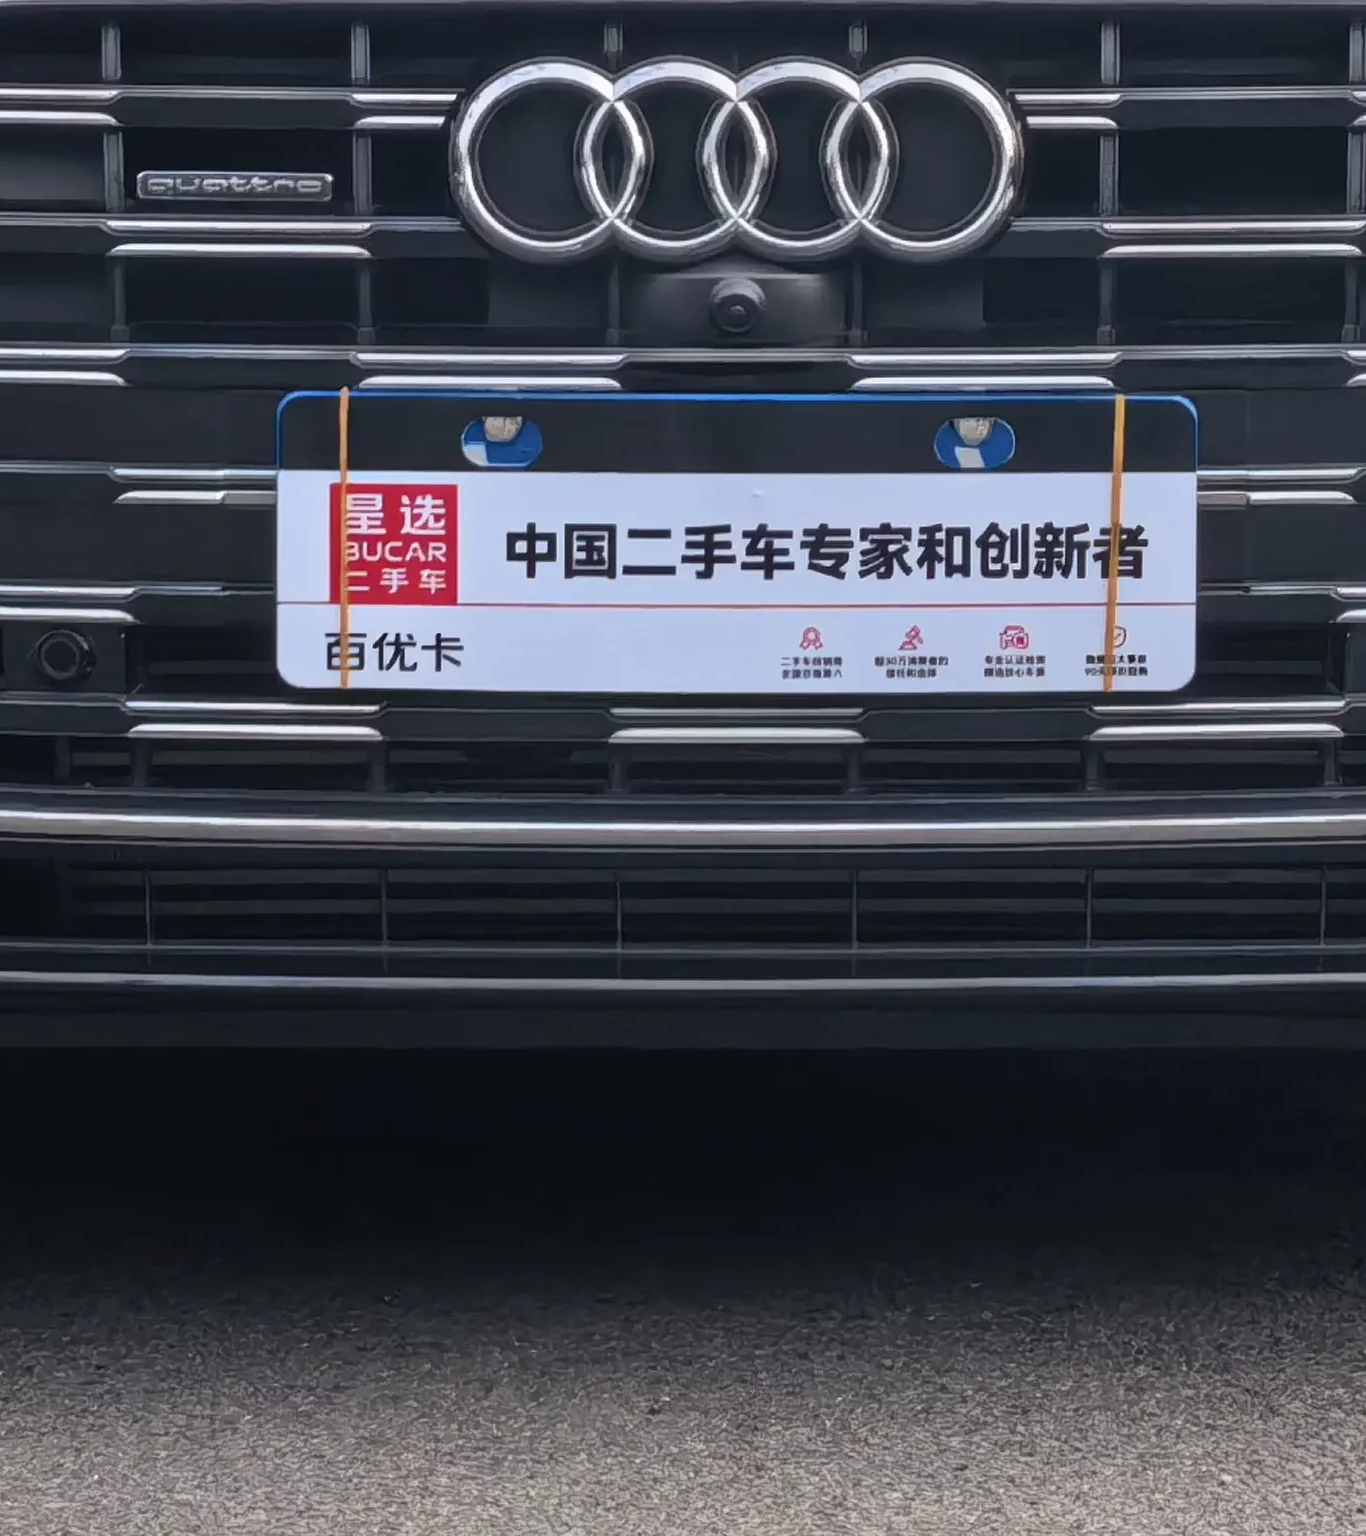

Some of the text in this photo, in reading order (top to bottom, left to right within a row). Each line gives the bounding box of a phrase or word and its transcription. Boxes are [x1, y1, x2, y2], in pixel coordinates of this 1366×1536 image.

[147, 175, 323, 196] quattro
[345, 493, 446, 535] 星选
[345, 541, 447, 562] BUCAR
[505, 522, 1149, 580] 中国二手车专家和创新者
[346, 567, 447, 594] 二手车
[324, 631, 465, 673] 百优卡
